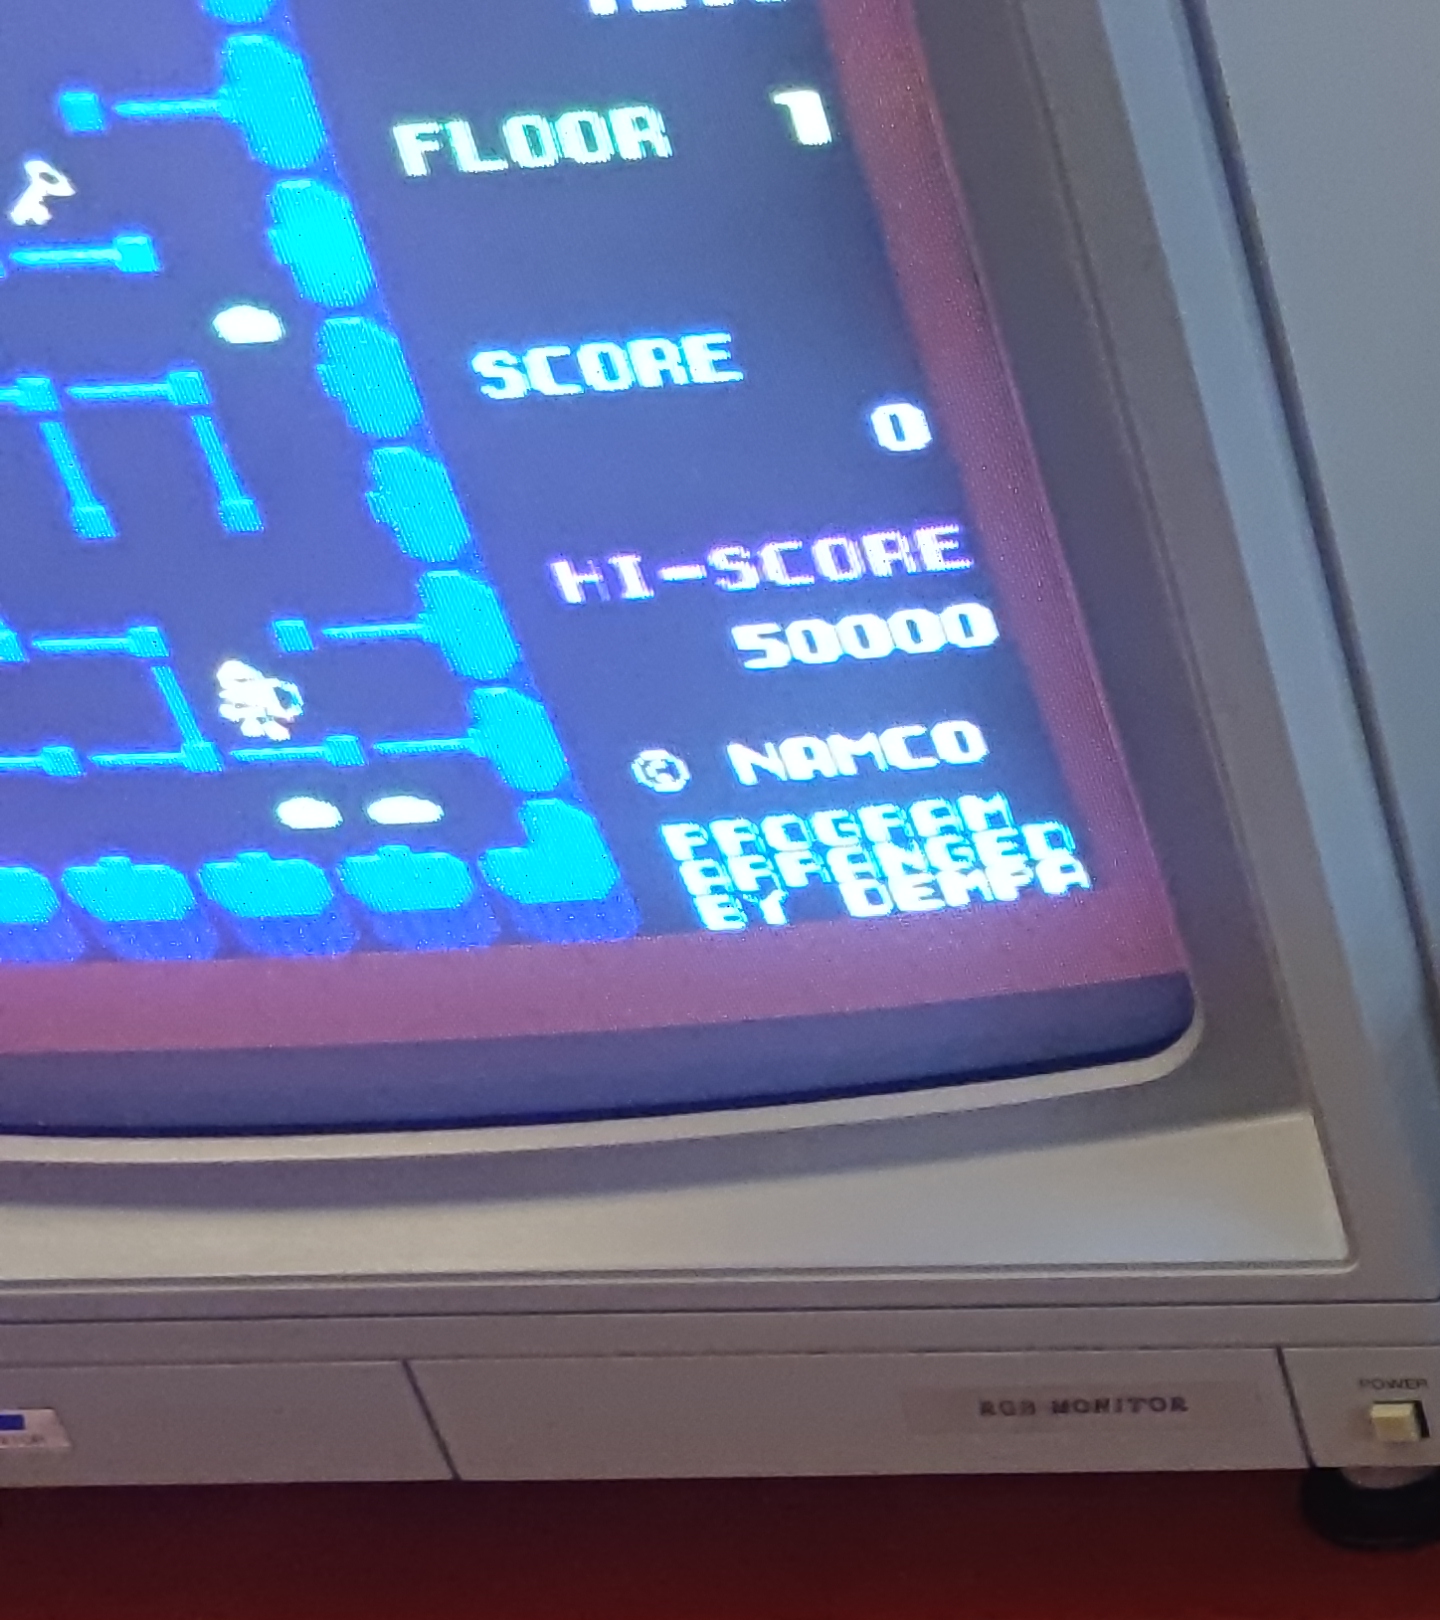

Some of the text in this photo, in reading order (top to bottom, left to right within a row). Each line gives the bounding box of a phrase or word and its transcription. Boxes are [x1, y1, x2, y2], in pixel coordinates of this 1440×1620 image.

[392, 87, 832, 178] FLOOR 1
[469, 328, 746, 401] SCORE
[868, 399, 933, 452] 0
[547, 523, 975, 604] HI-SCORE
[729, 602, 999, 671] 50000
[725, 716, 990, 789] NAMCO
[1049, 1396, 1189, 1415] MONITOR
[1358, 1377, 1428, 1391] POWER
